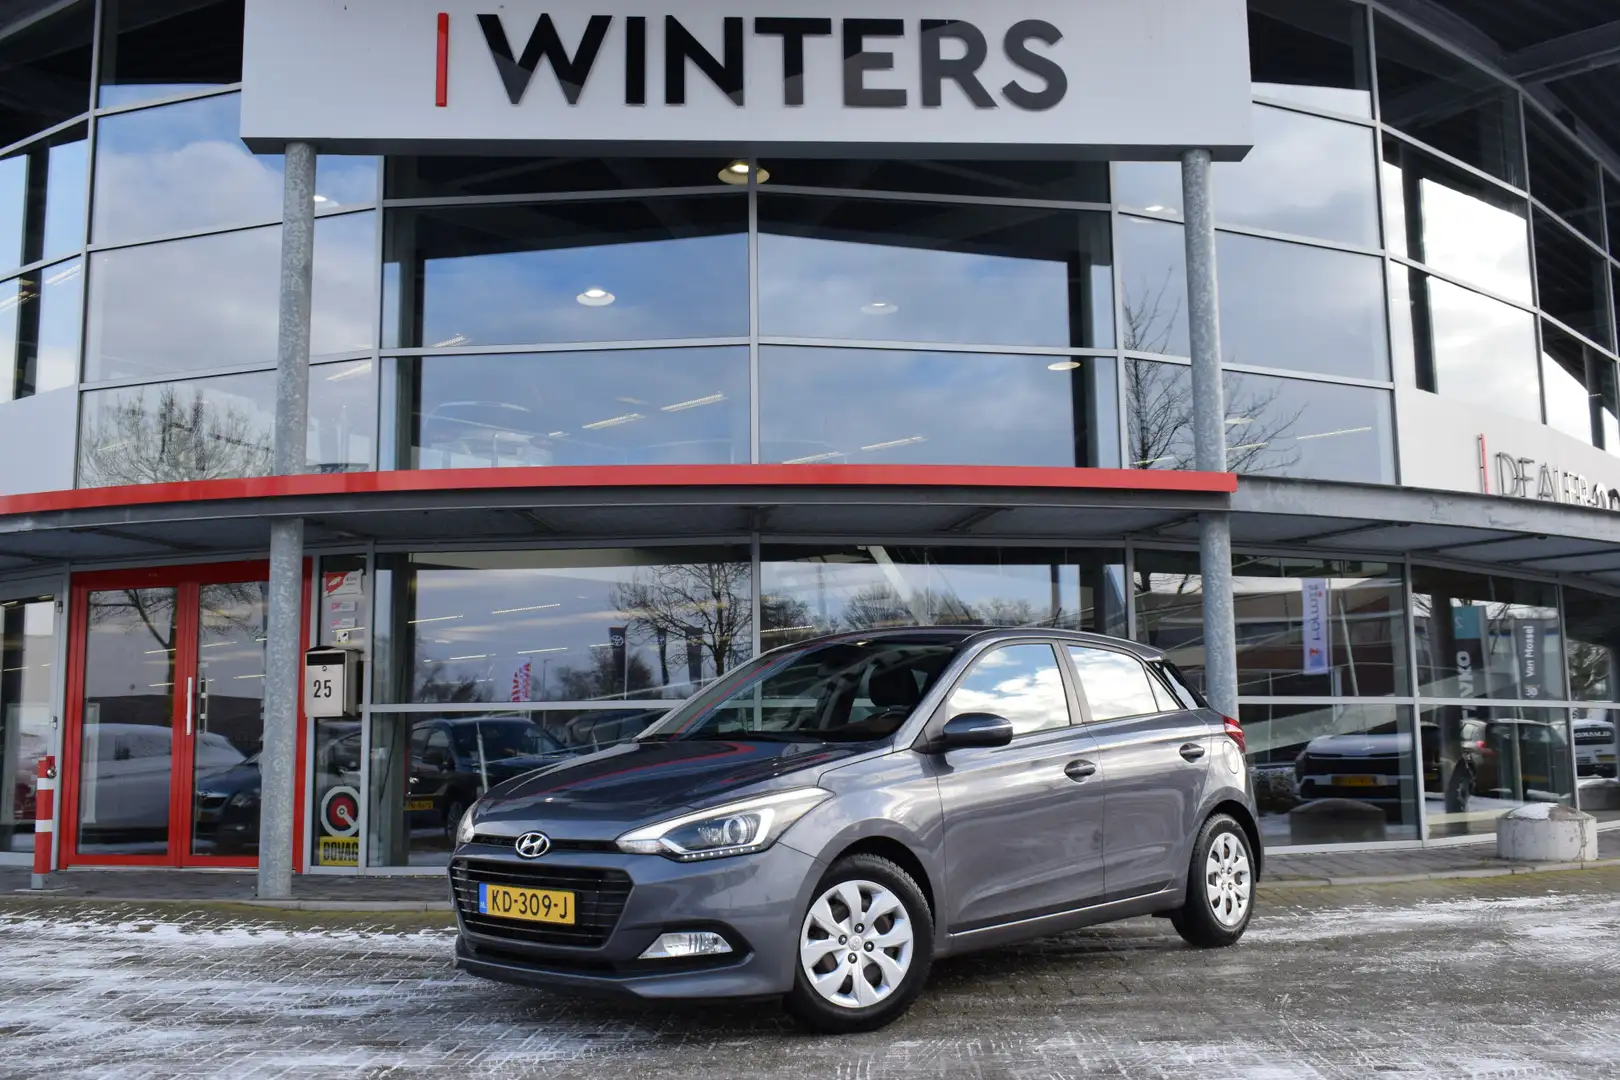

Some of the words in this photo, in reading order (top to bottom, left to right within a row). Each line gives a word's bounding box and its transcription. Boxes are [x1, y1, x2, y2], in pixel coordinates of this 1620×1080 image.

[476, 13, 1068, 112] WINTERS
[1522, 625, 1534, 658] Mossel
[1525, 660, 1535, 678] Van
[313, 679, 332, 699] 25
[492, 889, 568, 920] KD-309-J
